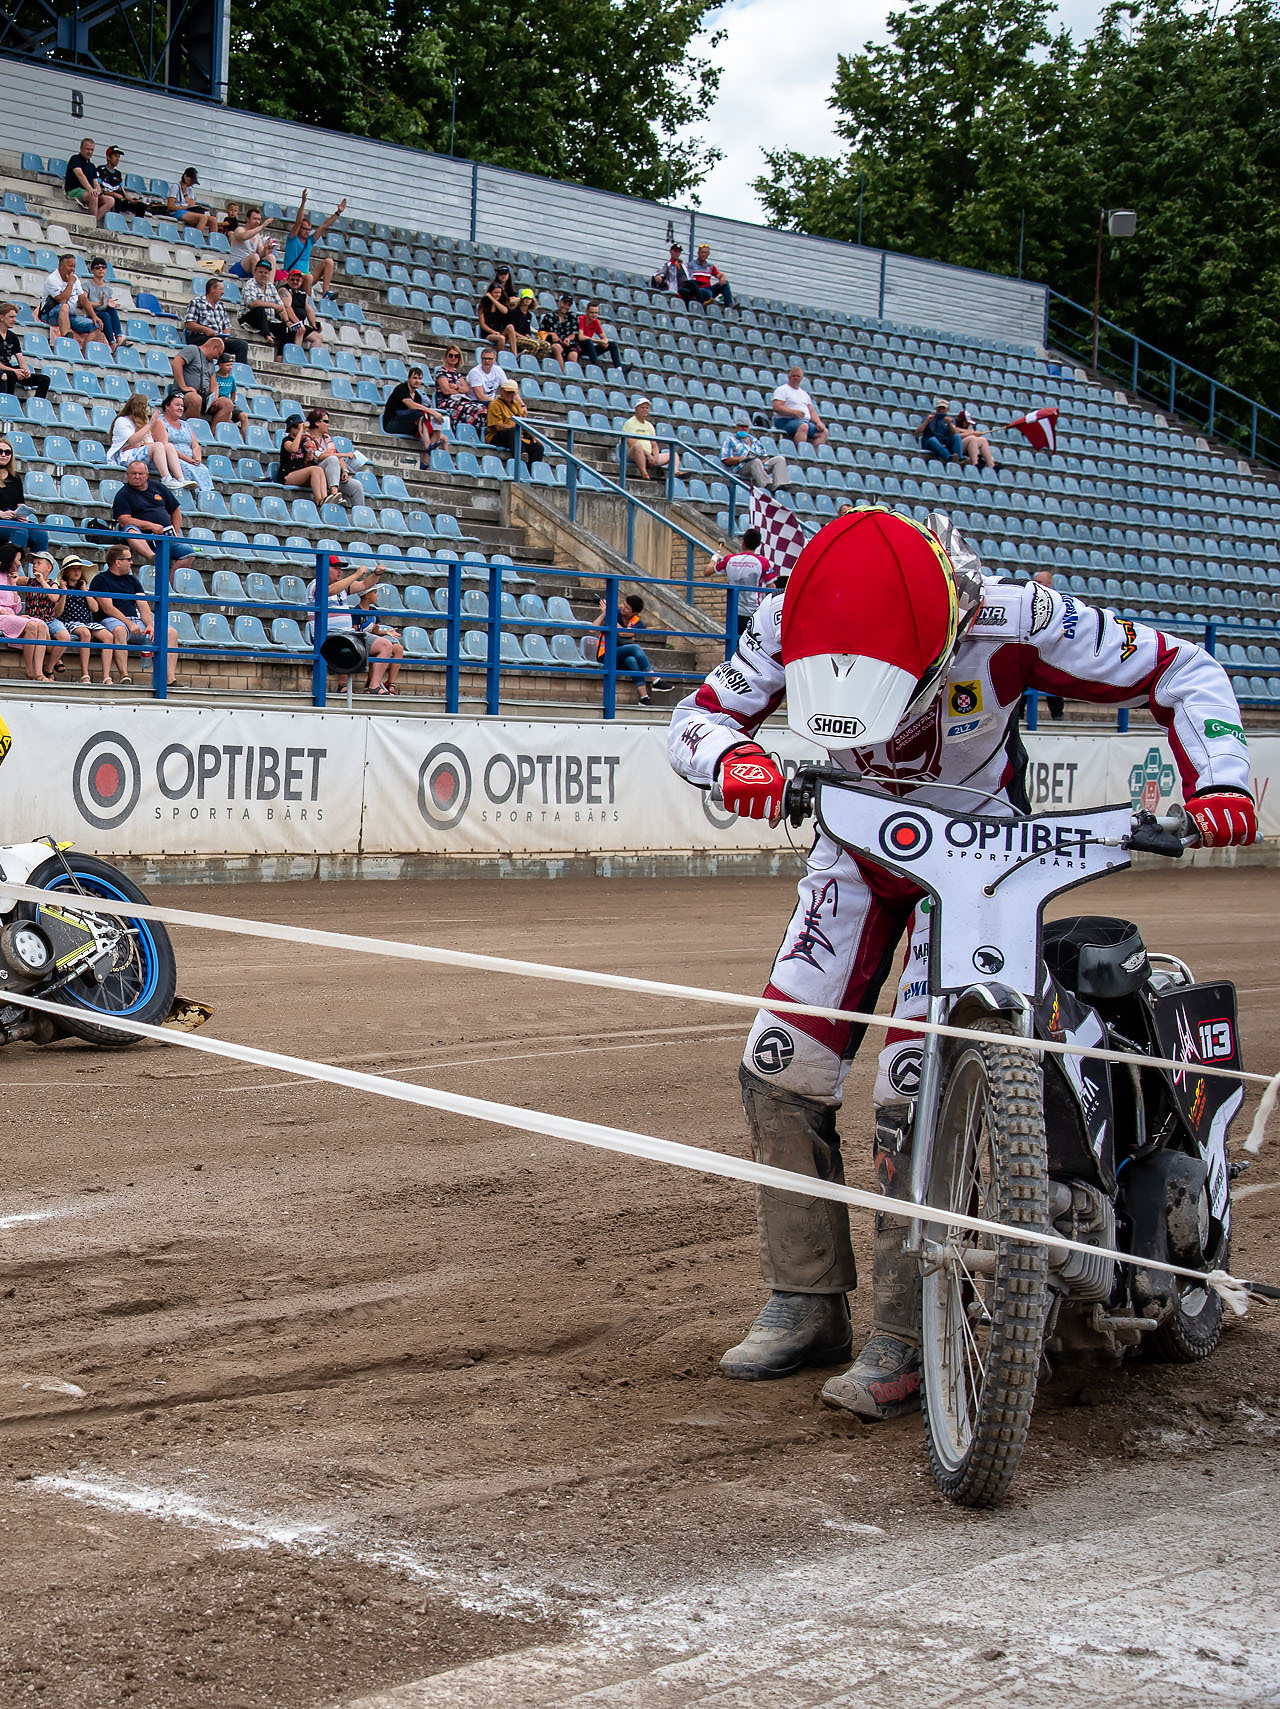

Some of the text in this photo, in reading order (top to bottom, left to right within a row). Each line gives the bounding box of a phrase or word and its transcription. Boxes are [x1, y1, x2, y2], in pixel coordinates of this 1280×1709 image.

[72, 89, 84, 118] B
[813, 717, 858, 735] SHOEI
[894, 711, 937, 745] DAUGAVPILS
[921, 719, 936, 732] CLUB
[156, 742, 327, 801] OPTIBET
[483, 753, 620, 804] OPTIBET
[155, 804, 324, 821] SPORTA BĀRS
[482, 808, 619, 823] SPORTA BĀRS
[945, 818, 1093, 860] OPTIBET
[946, 850, 1087, 870] SPORTA BĀRS
[1199, 1022, 1231, 1059] 113
